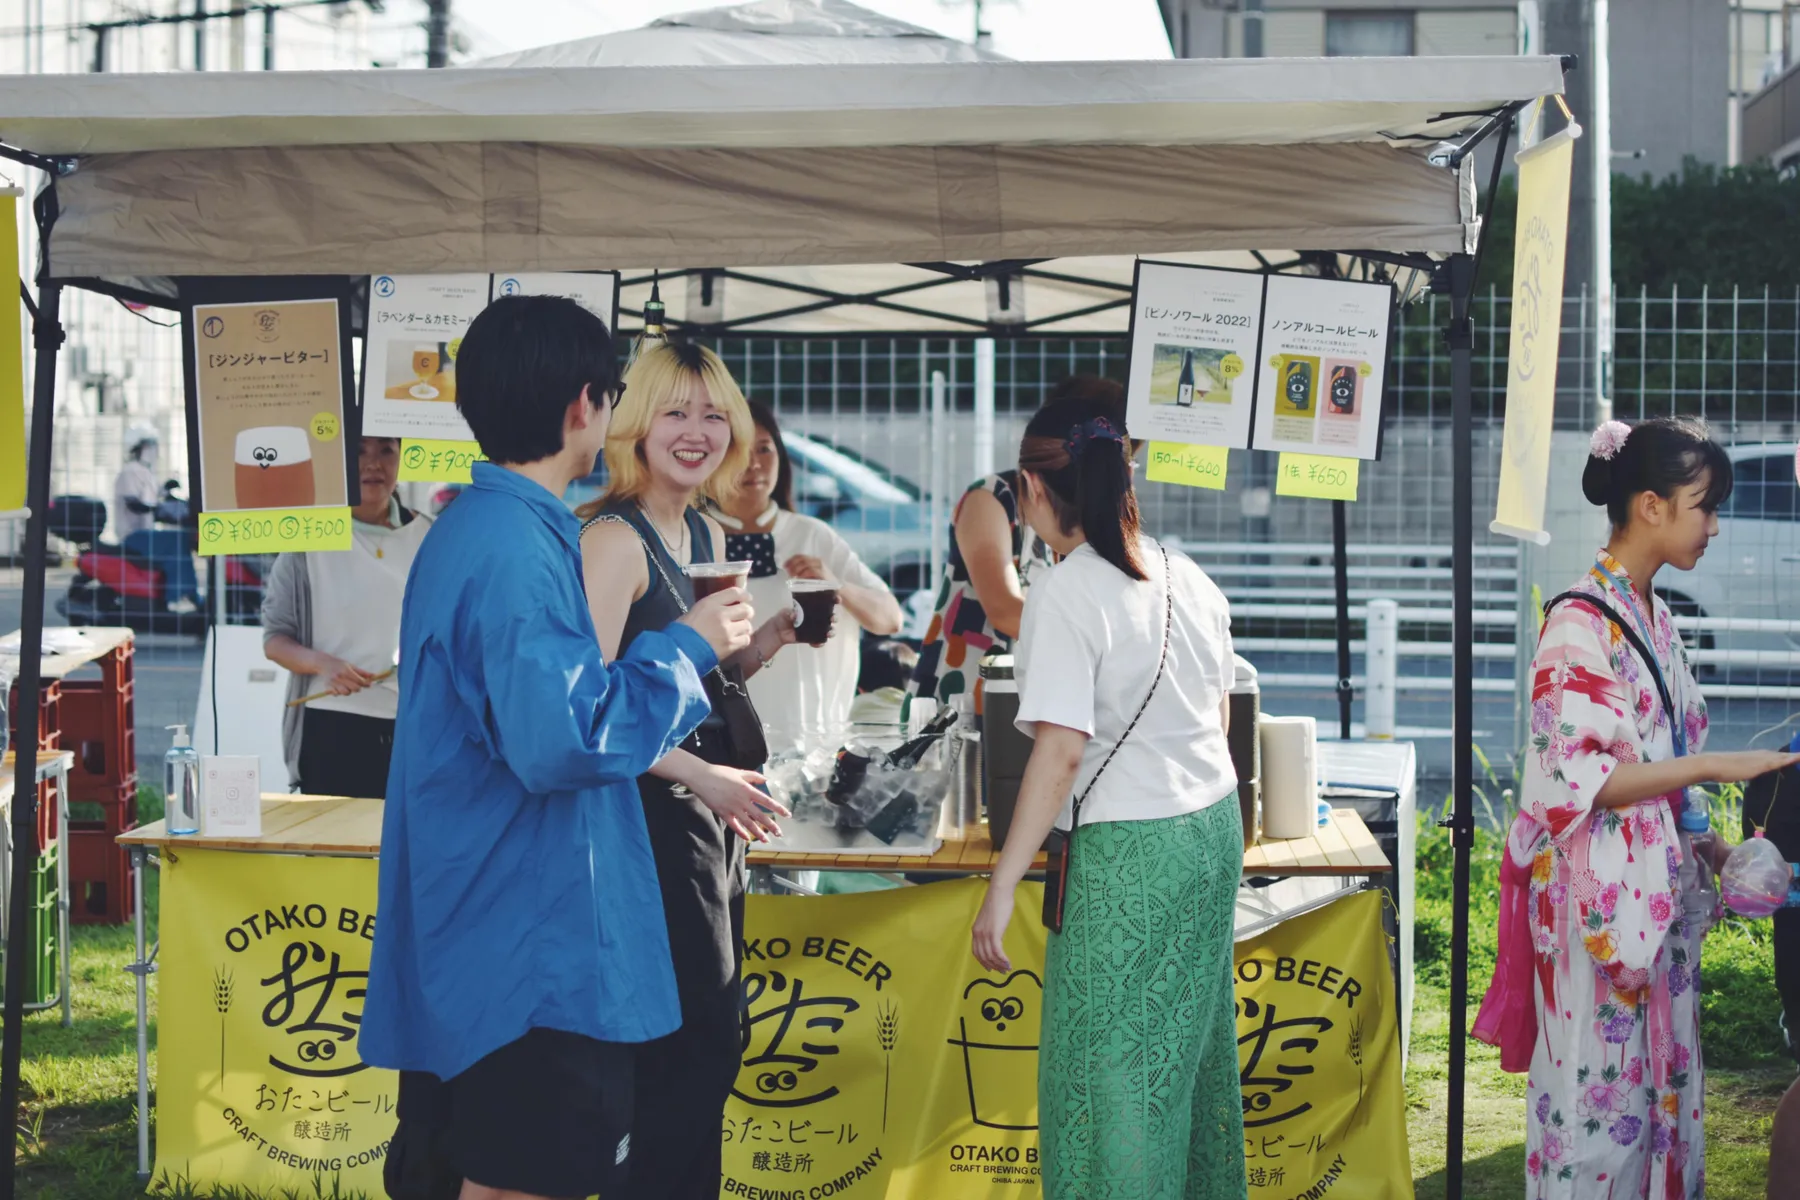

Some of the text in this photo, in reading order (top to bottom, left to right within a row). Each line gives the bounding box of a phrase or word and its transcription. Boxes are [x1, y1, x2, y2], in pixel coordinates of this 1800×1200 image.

[1272, 320, 1378, 338] ノンアルコールビール
[1187, 454, 1220, 477] ¥600
[1308, 464, 1347, 486] ¥650
[303, 516, 345, 539] ¥500
[225, 903, 327, 953] OTAKO
[742, 936, 892, 992] KO BEER
[1275, 956, 1362, 1008] BEER
[255, 1084, 394, 1114] おたこビール
[222, 1107, 268, 1152] CRAFT
[266, 1145, 342, 1172] BREWING
[950, 1145, 1020, 1163] OTAKO
[723, 1147, 883, 1200] BREWING COMPANY
[950, 1164, 981, 1173] CRAFT
[983, 1165, 1028, 1175] BREWING
[1288, 1153, 1347, 1200] MPANY
